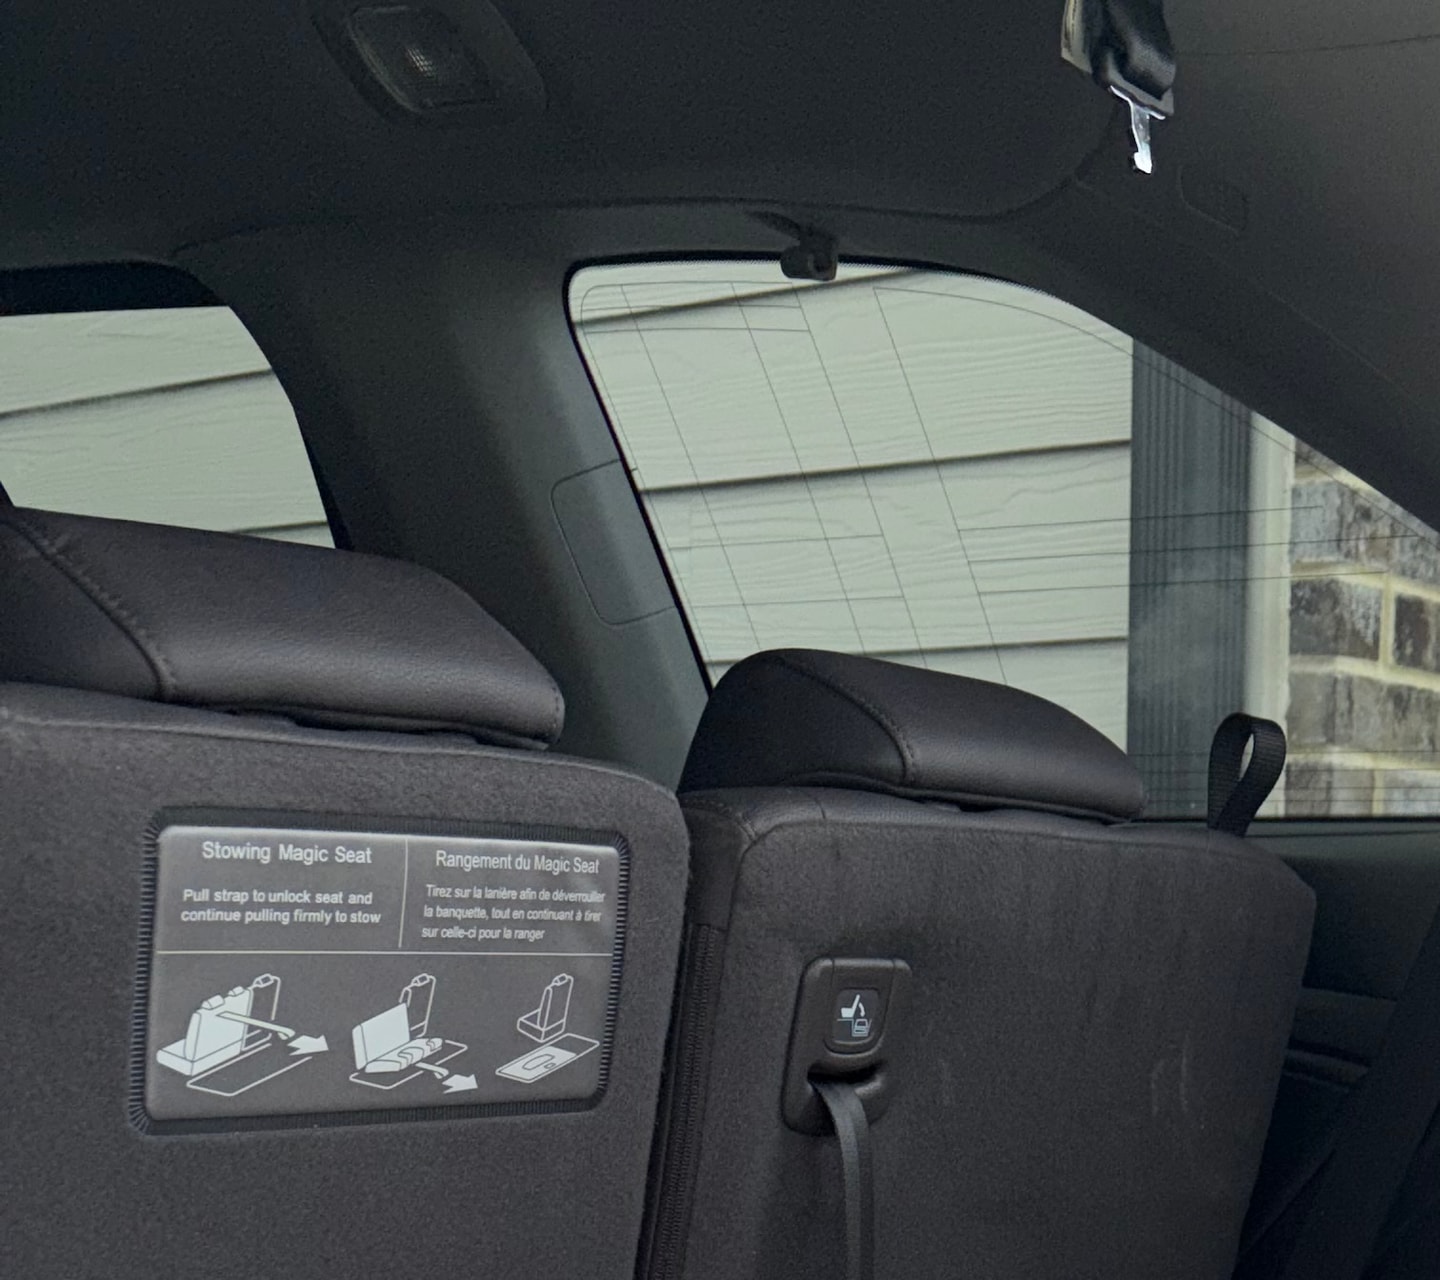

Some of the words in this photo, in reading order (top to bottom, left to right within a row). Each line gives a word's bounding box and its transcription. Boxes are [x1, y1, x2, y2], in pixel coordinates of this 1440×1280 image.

[202, 841, 271, 864] Stowing
[278, 844, 329, 865] Magic
[334, 845, 373, 864] Seat
[436, 850, 511, 872] Rangement
[514, 854, 531, 871] du
[533, 855, 570, 875] Magic
[573, 857, 600, 874] Seat
[182, 888, 210, 902] Pull
[213, 889, 249, 904] strap
[252, 890, 265, 903] to
[268, 889, 311, 904] unlock
[314, 891, 343, 904] seat
[347, 891, 373, 905] and
[426, 884, 451, 899] Tirez
[454, 888, 471, 899] sur
[473, 886, 482, 899] la
[519, 887, 537, 900] afin
[538, 888, 551, 900] de
[181, 908, 241, 922] continue
[244, 908, 290, 925] pulling
[293, 909, 331, 925] firmly
[335, 910, 347, 923] to
[350, 911, 381, 924] stow
[423, 905, 433, 918] la
[435, 905, 489, 920] banquette,
[491, 907, 511, 919] tout
[512, 910, 525, 920] en
[527, 908, 574, 921] continuant
[584, 910, 602, 922] tirer
[421, 927, 438, 938] sur
[440, 926, 477, 939] celle-ci
[478, 928, 501, 942] pour
[503, 926, 512, 939] la
[514, 928, 545, 942] ranger
